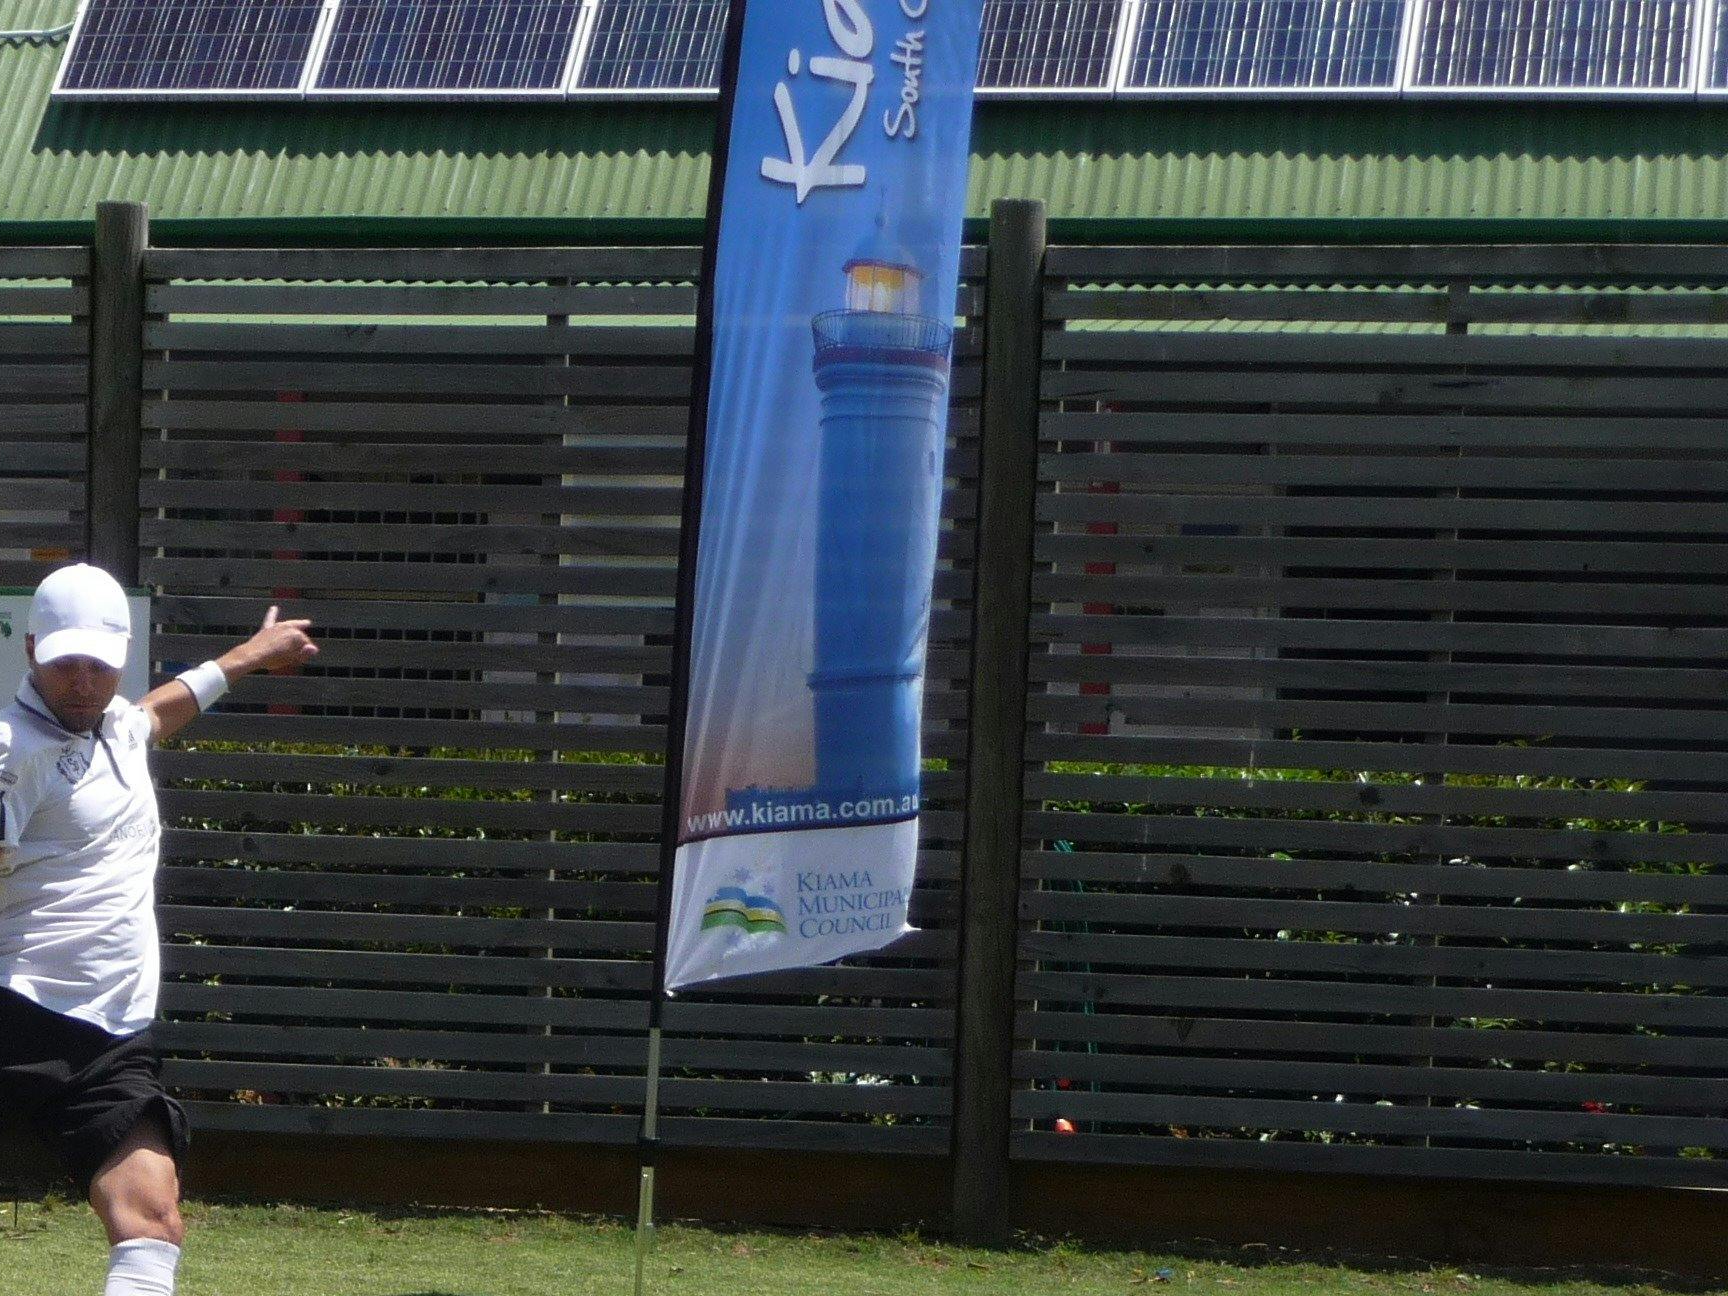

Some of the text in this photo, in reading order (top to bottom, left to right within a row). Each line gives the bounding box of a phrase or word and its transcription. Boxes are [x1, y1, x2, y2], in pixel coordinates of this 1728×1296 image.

[883, 31, 925, 138] South
[687, 794, 920, 832] www.kiama.com.au
[797, 870, 874, 892] KIAMA
[800, 912, 893, 938] COUNCIL
